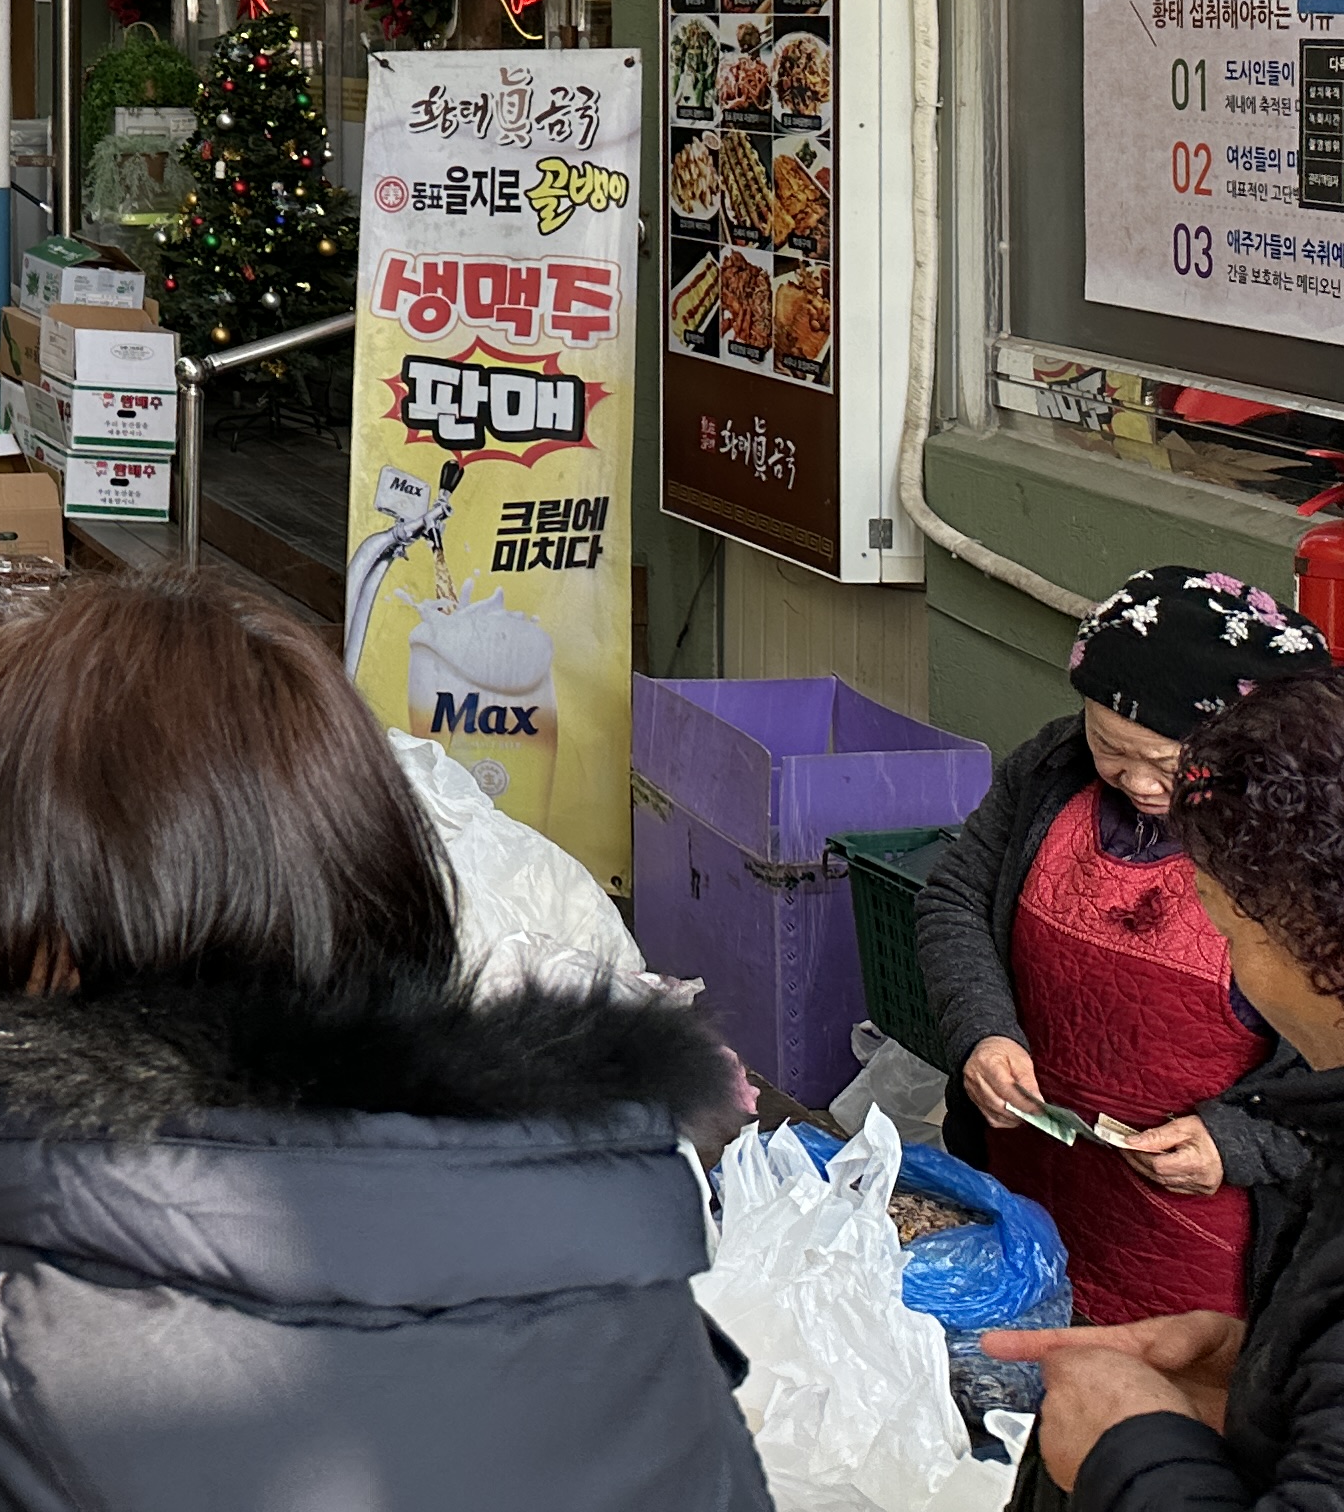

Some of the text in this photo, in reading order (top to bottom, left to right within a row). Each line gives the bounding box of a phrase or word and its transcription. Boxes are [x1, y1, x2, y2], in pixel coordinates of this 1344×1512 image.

[1188, 0, 1292, 31] 섭취해야하는
[1171, 58, 1208, 113] 01
[1224, 59, 1295, 87] 도시인들이
[1224, 94, 1293, 117] 체내에 축적된
[1171, 140, 1213, 197] 02
[1226, 144, 1282, 173] 여성들의
[524, 156, 629, 236] 골뱅이
[1226, 179, 1269, 202] 대표적인
[1172, 223, 1213, 279] 03
[1226, 229, 1297, 258] 애주가들의
[1226, 263, 1248, 285] 간을
[1250, 265, 1294, 289] 보호하는
[375, 253, 617, 345] 생맥주
[403, 355, 582, 446] 판매
[390, 476, 424, 497] Max
[496, 495, 610, 536] 크림에
[491, 535, 604, 572] 미치다
[430, 690, 541, 736] Max
